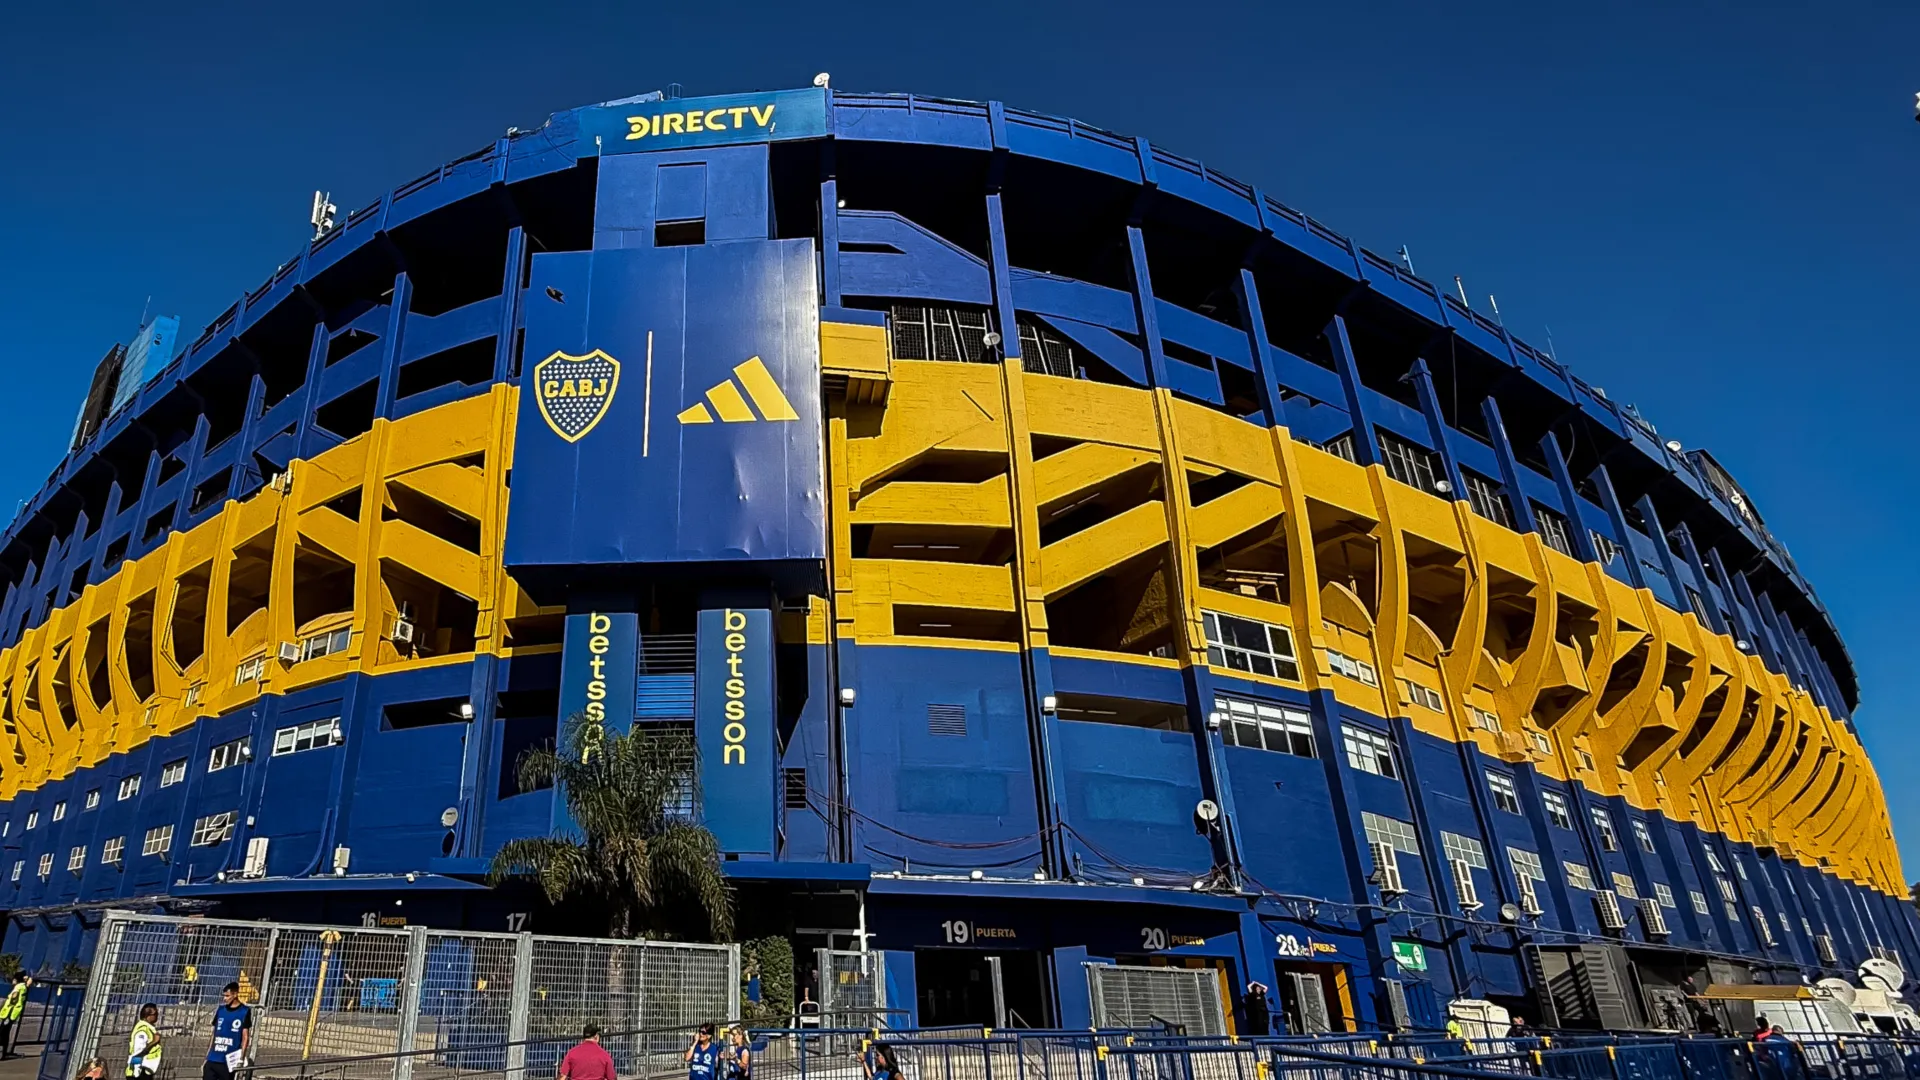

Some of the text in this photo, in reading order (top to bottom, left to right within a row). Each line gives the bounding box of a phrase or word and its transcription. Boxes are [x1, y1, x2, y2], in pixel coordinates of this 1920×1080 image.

[625, 105, 775, 140] DIRECTV
[544, 378, 609, 398] CABJ
[723, 608, 747, 765] betsson
[361, 912, 376, 928] 16
[506, 913, 527, 931] 17
[941, 920, 1017, 943] 19 PUERTA
[1141, 927, 1166, 950] 20
